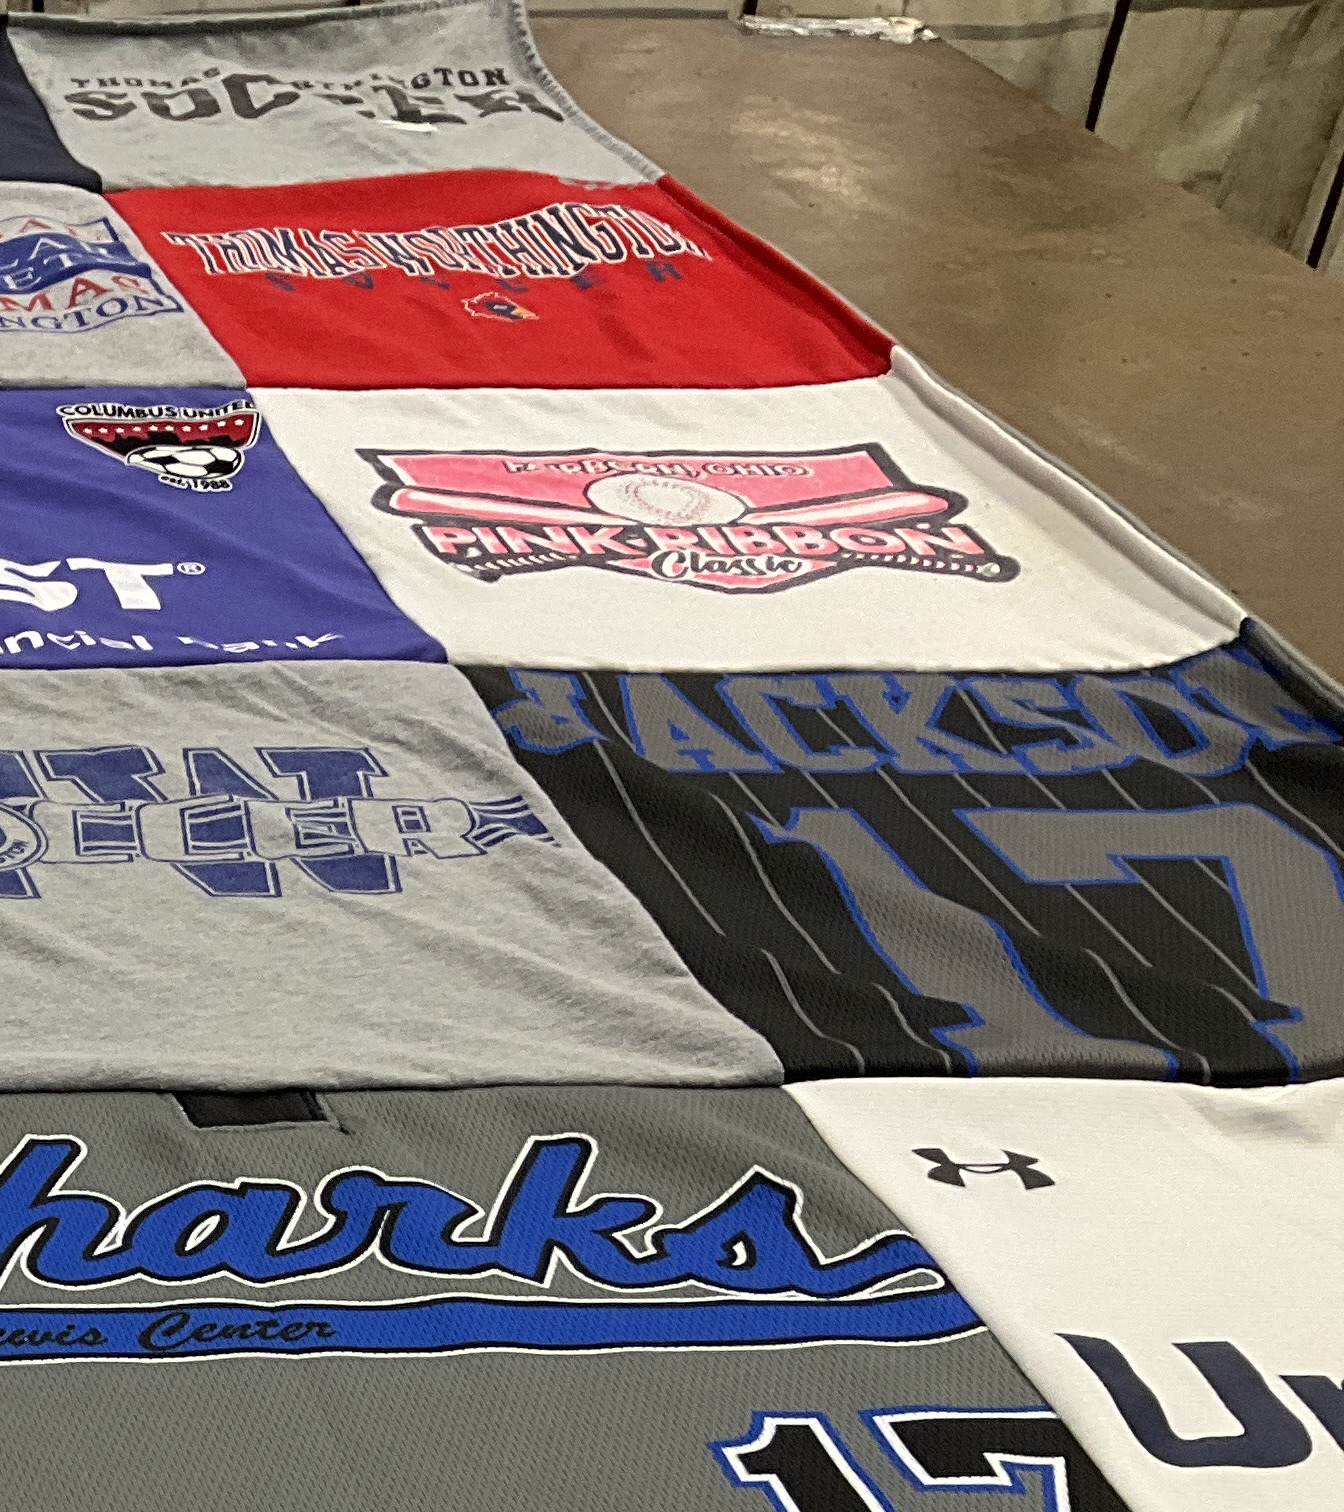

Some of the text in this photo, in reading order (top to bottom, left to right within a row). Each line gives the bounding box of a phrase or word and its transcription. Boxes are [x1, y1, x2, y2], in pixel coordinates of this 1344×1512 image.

[64, 73, 564, 125] SOCER
[59, 405, 178, 419] COLUMBUS
[193, 478, 230, 490] 1988
[651, 549, 802, 578] Classic
[750, 804, 1344, 1085] 17
[140, 1309, 339, 1353] Center
